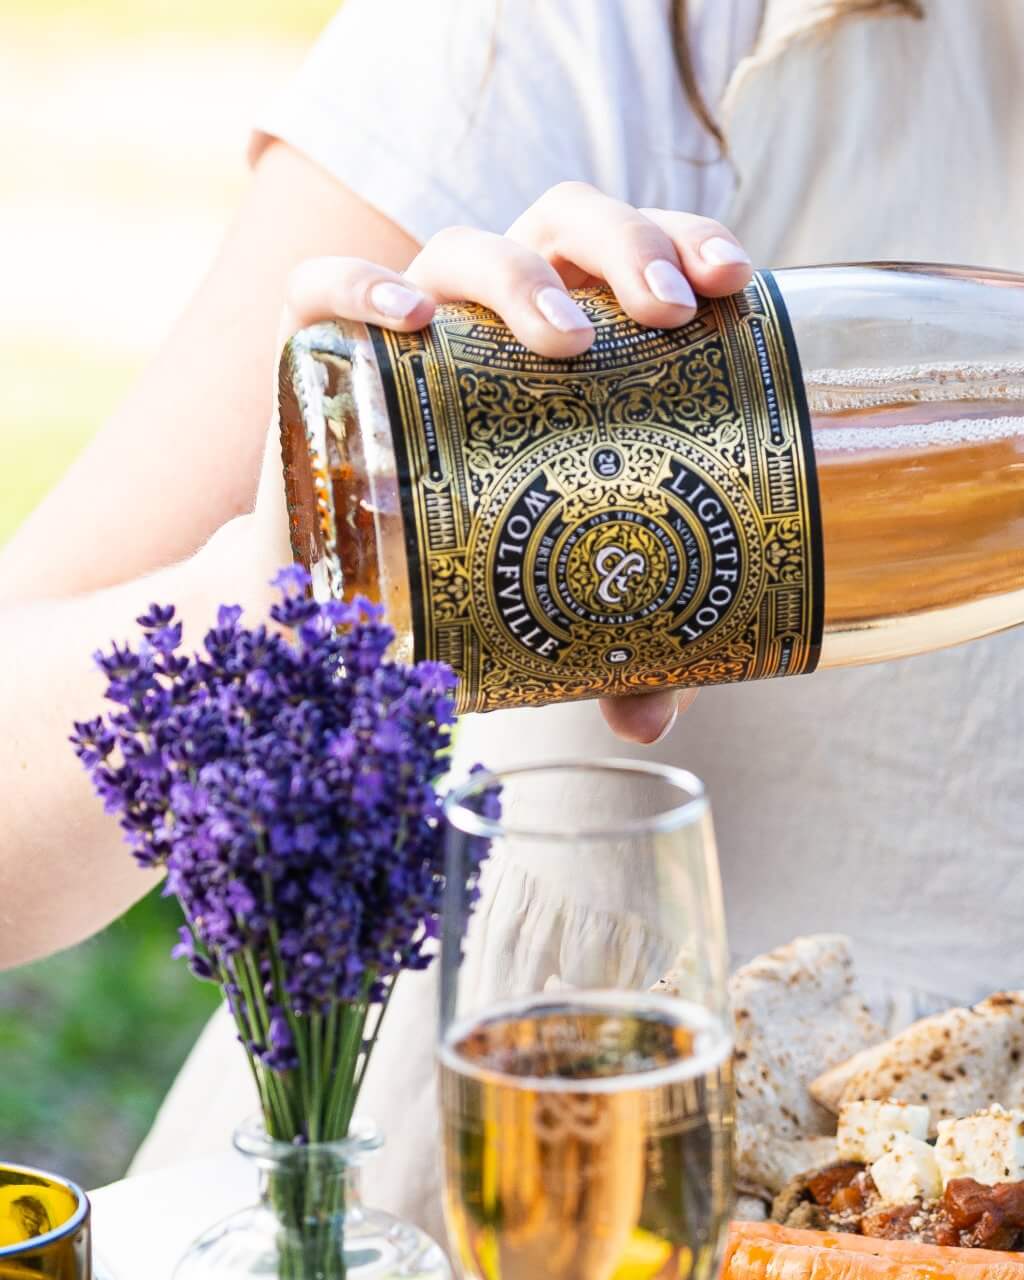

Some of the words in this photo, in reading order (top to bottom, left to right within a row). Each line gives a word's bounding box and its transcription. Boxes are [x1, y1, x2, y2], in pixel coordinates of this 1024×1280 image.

[766, 388, 780, 434] VALLEY
[598, 453, 618, 475] 20
[616, 511, 644, 523] THE
[674, 518, 698, 556] NOVA
[497, 488, 560, 657] WOLFVILLE
[535, 535, 554, 577] BRUT
[670, 469, 739, 641] LIGHTFOOT
[677, 557, 699, 605] SCOTIA
